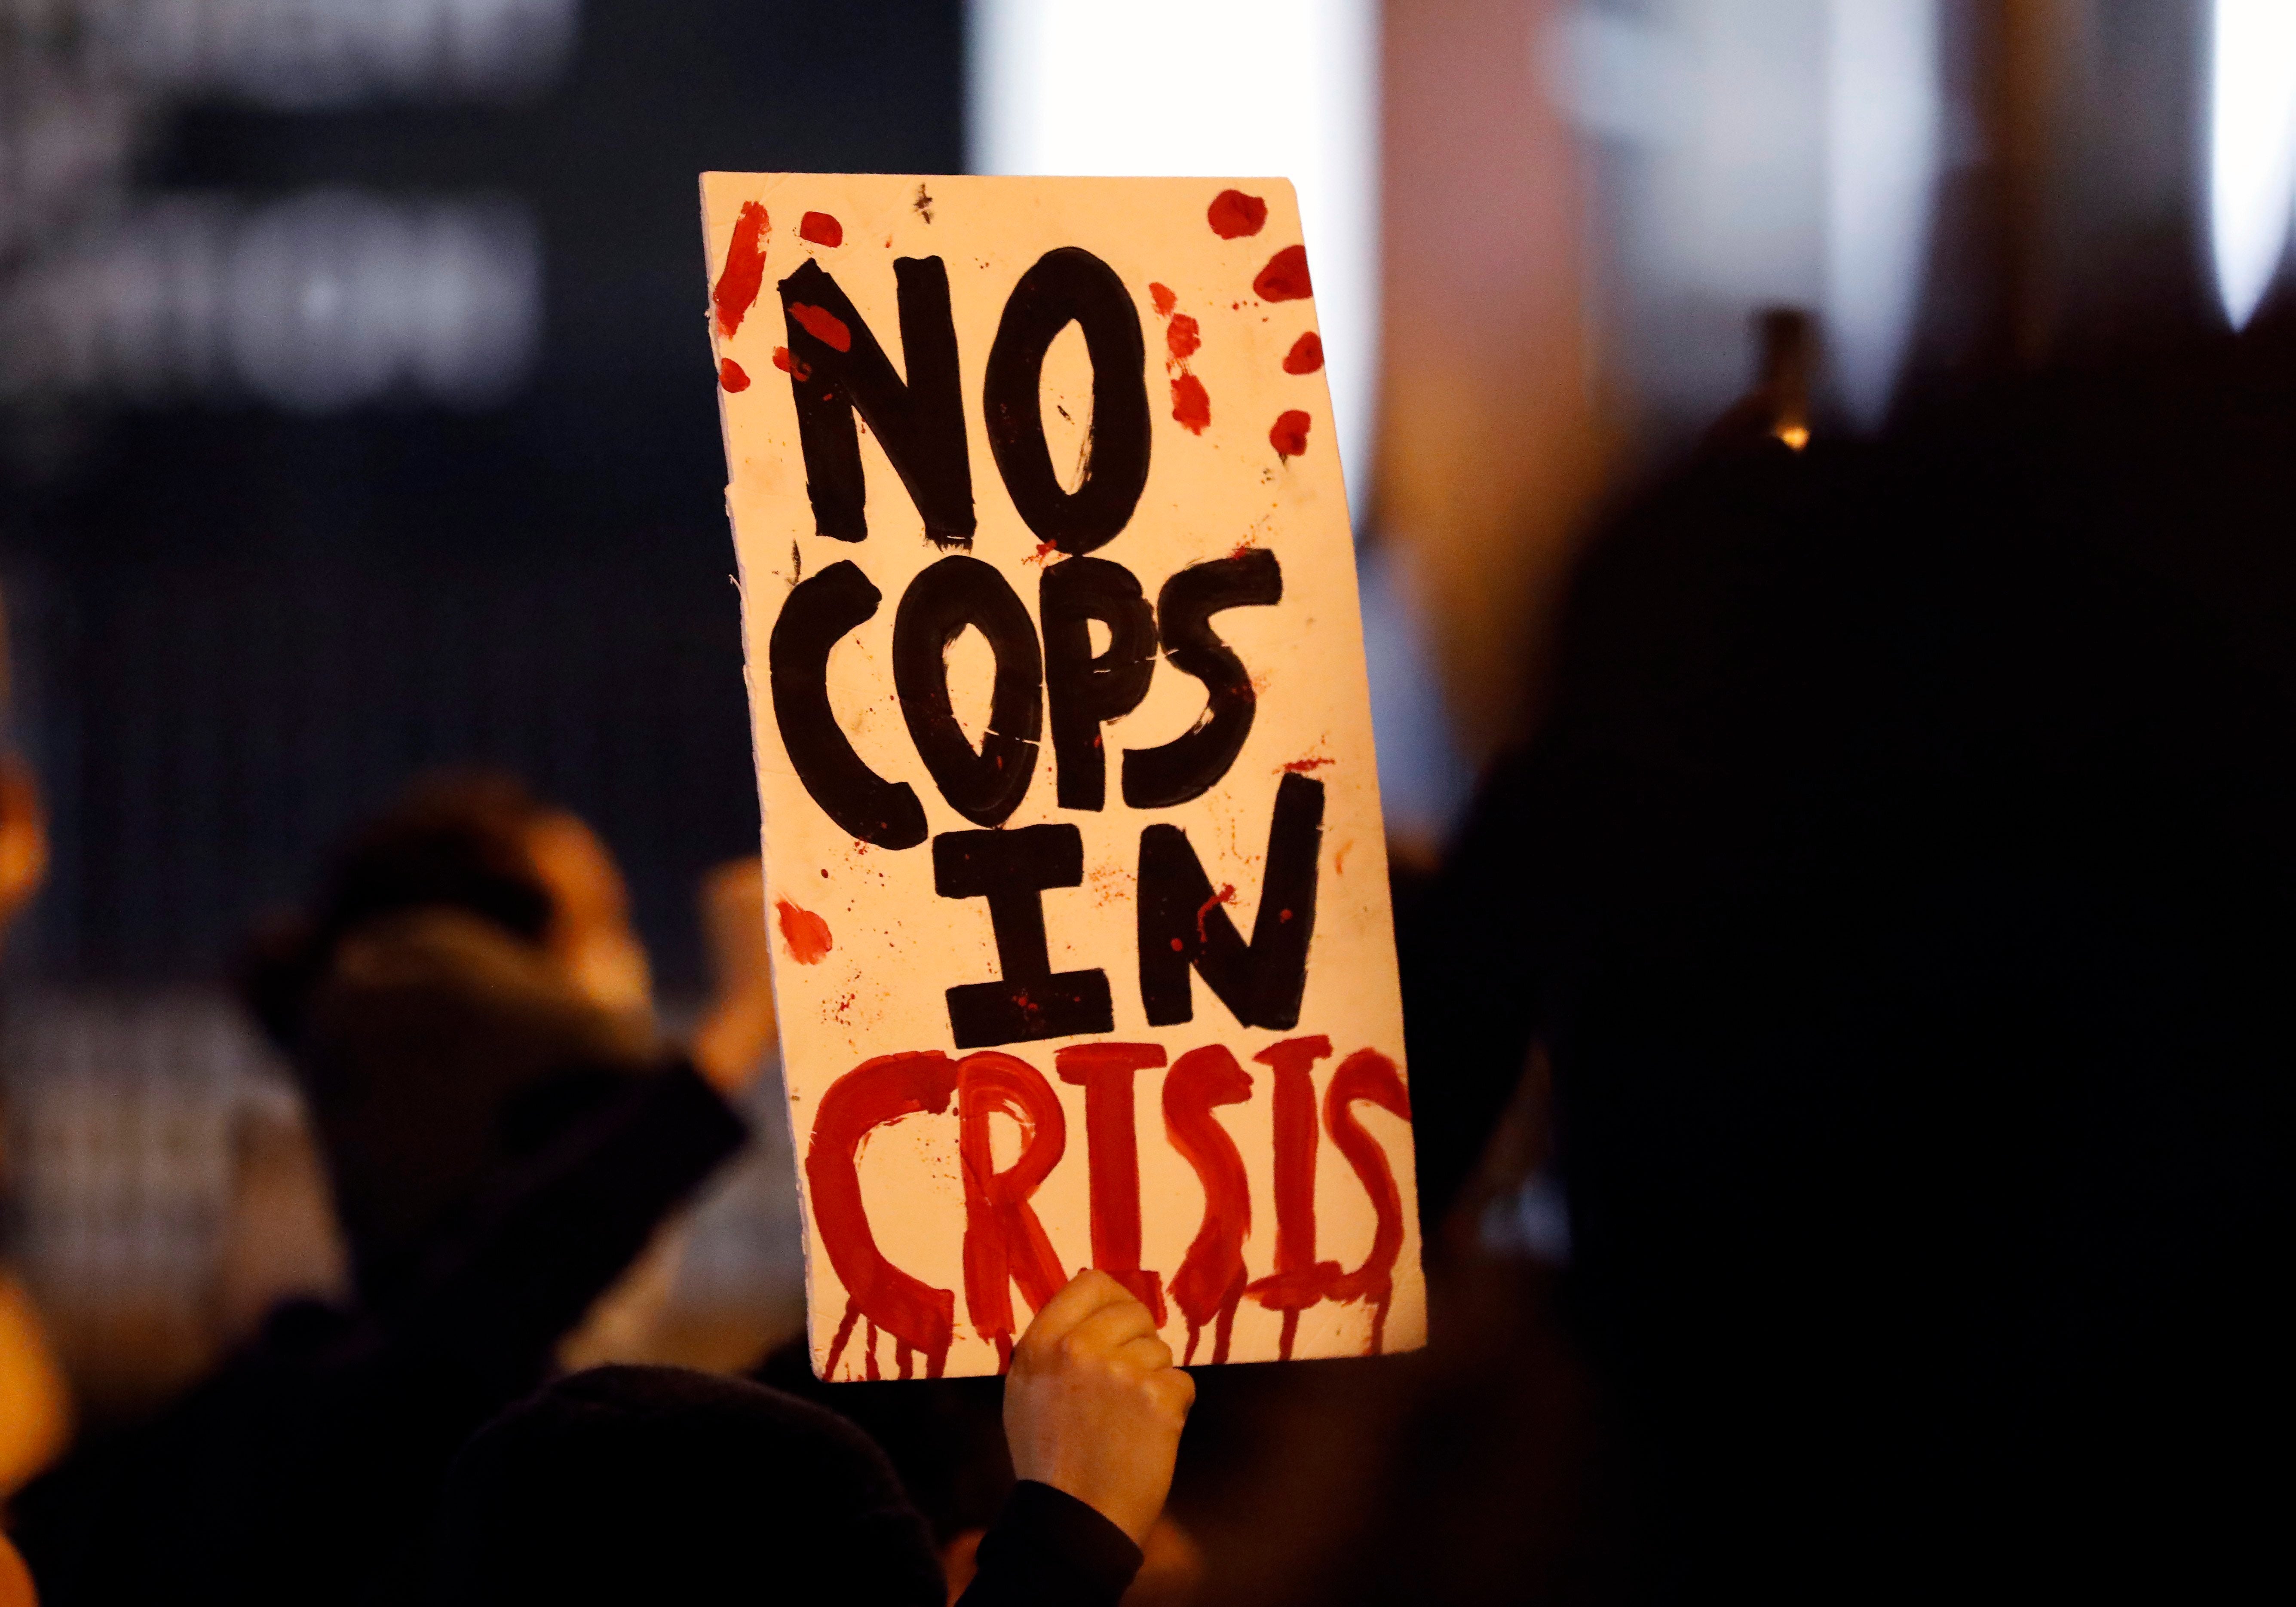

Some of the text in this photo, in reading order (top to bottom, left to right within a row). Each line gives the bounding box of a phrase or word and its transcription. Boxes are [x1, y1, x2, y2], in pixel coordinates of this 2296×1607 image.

[777, 247, 1152, 554] NO
[770, 548, 1283, 850] COPS
[932, 772, 1325, 1049] IN
[805, 1035, 1412, 1356] CRISIS
